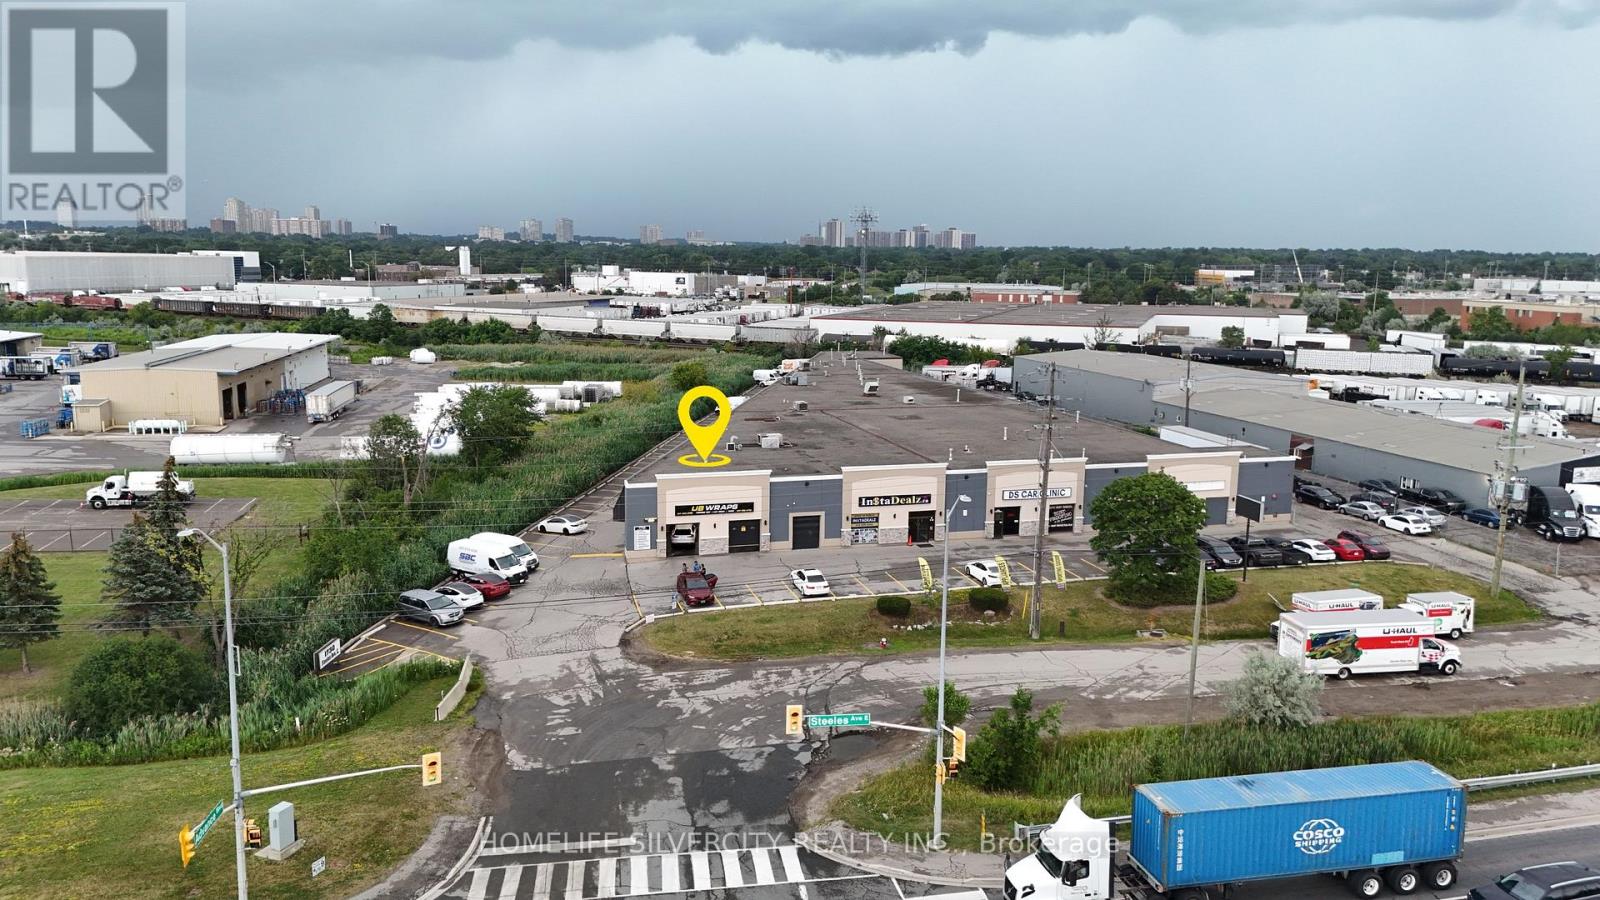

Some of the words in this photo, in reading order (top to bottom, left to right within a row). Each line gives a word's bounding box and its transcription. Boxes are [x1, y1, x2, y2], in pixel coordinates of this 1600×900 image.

[1008, 491, 1019, 499] DS
[1021, 490, 1038, 498] CAR
[705, 503, 739, 511] WRAPS
[1382, 626, 1418, 635] U-HAUL
[810, 716, 849, 726] Steeles
[1293, 827, 1345, 841] COSCO
[1294, 836, 1343, 848] SHIPPING
